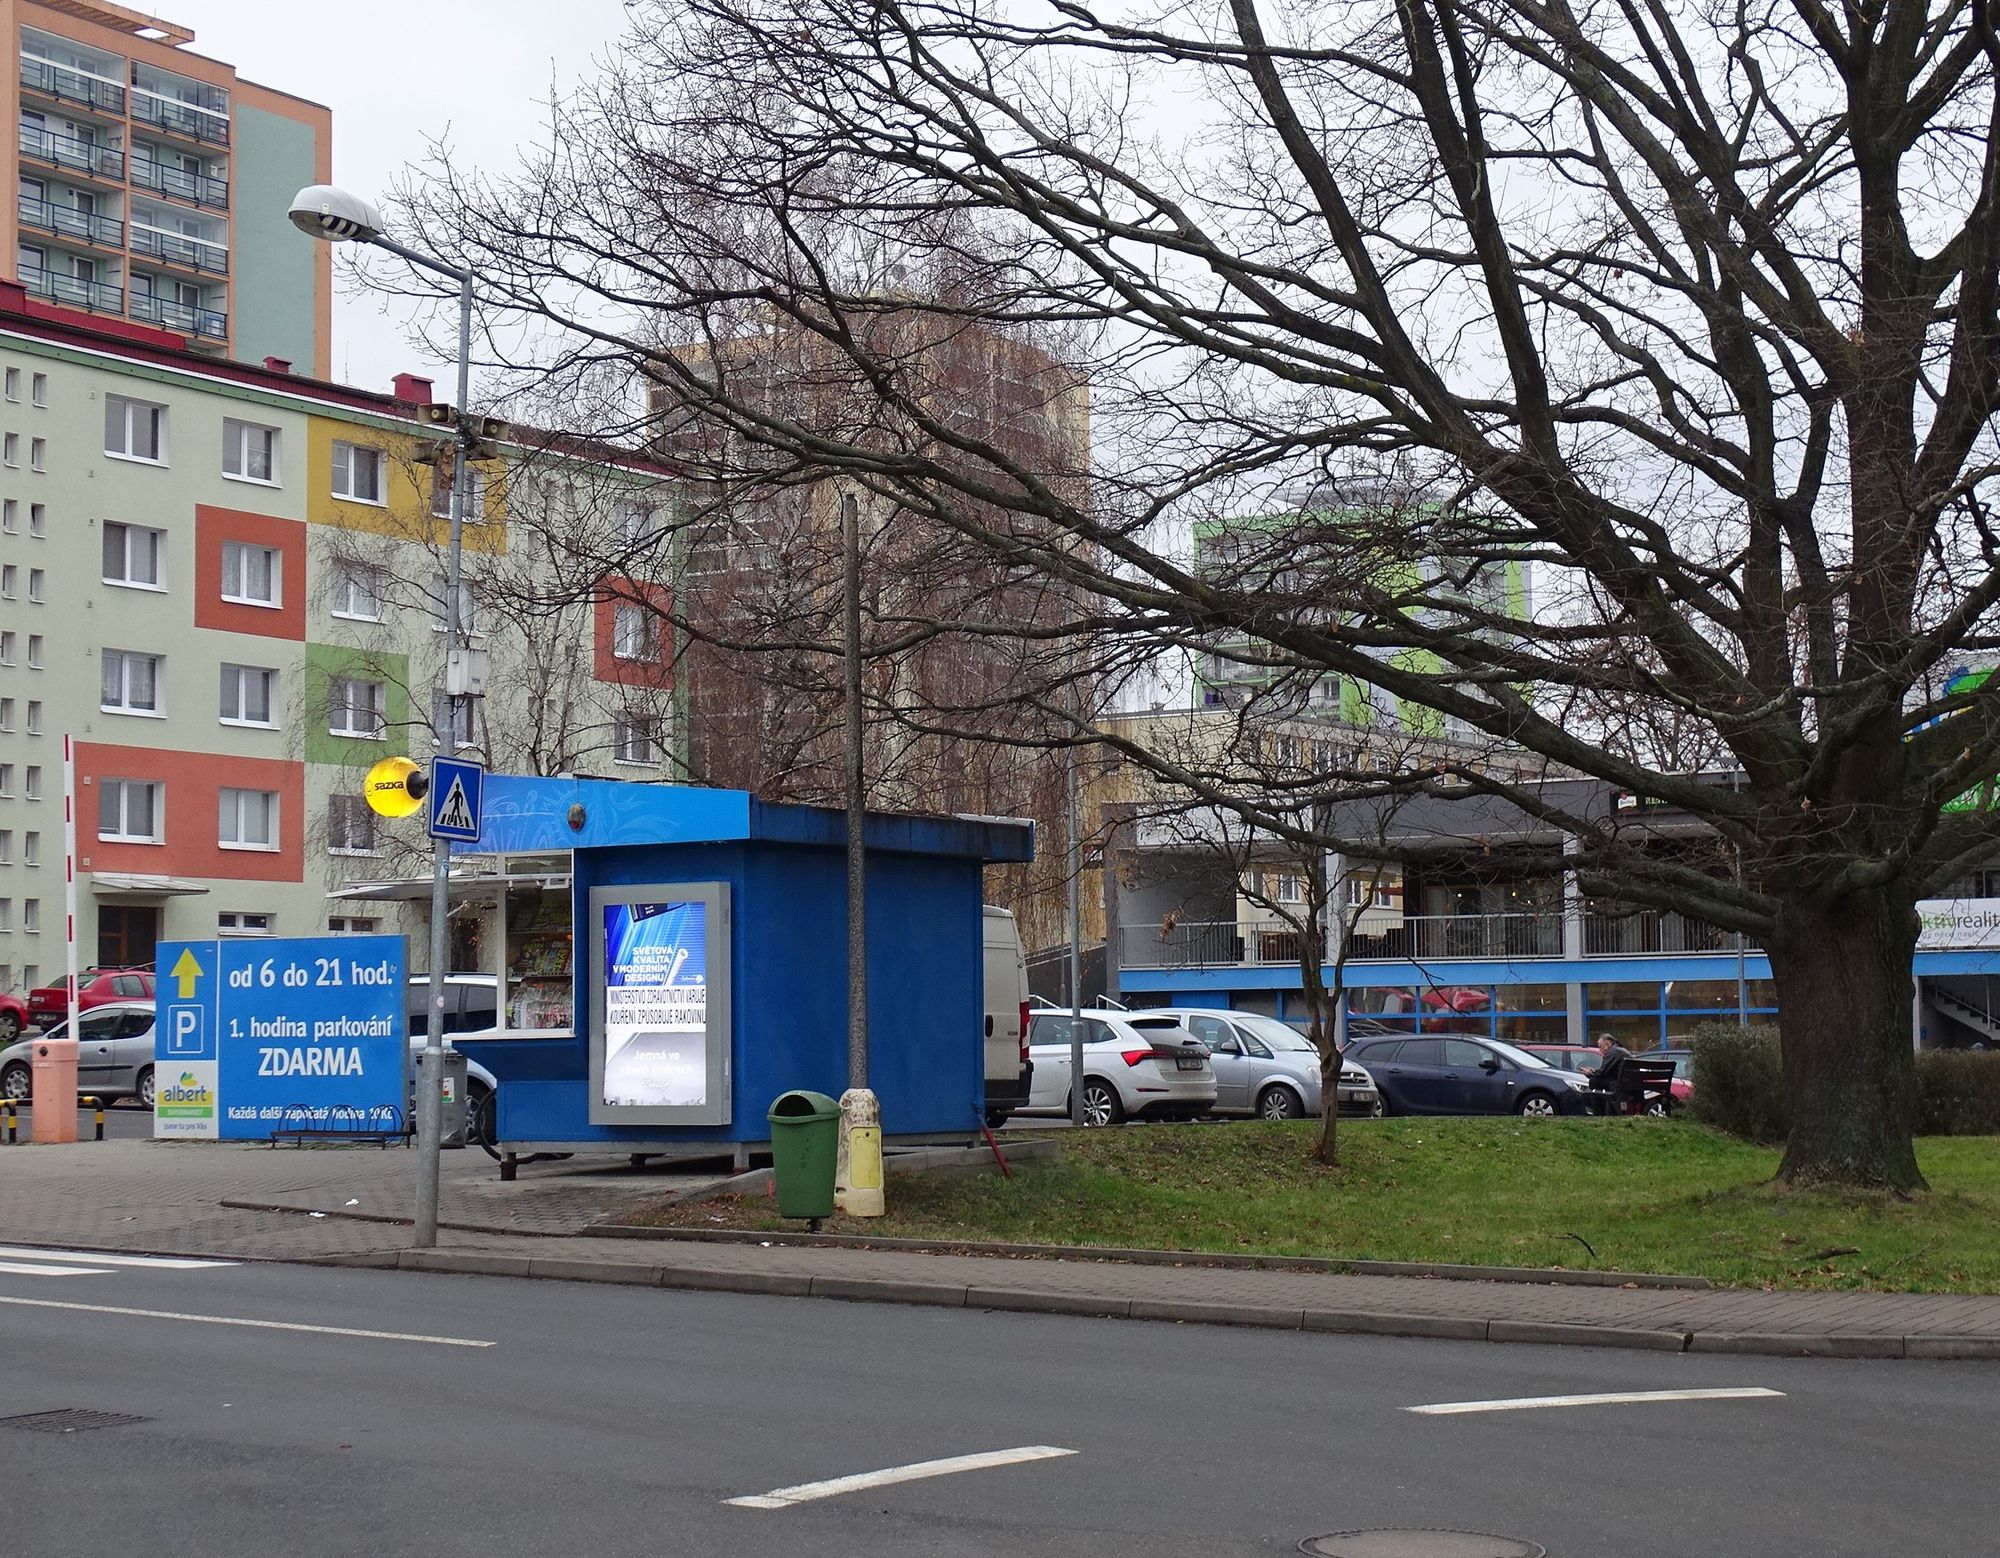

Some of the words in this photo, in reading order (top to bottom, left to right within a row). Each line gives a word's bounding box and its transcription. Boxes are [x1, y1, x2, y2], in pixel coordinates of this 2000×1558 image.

[375, 781, 403, 790] sazka
[1921, 910, 2000, 930] ktivrealit
[632, 944, 674, 955] SVĚTOVÁ
[633, 955, 670, 964] KVALITA
[229, 963, 253, 988] od
[260, 957, 276, 988] 6
[283, 962, 309, 987] do
[314, 957, 343, 987] 21
[351, 960, 393, 986] hod.
[624, 973, 665, 983] DESIGNU
[674, 1009, 706, 1025] RAKOVINU
[176, 1010, 197, 1048] P
[229, 1018, 244, 1038] 1.
[250, 1016, 307, 1038] hodina
[314, 1014, 393, 1043] parkování
[258, 1047, 364, 1077] ZDARMA
[632, 1049, 667, 1061] Jemná
[163, 1085, 207, 1103] albert
[227, 1106, 257, 1120] Každá
[260, 1106, 282, 1120] další
